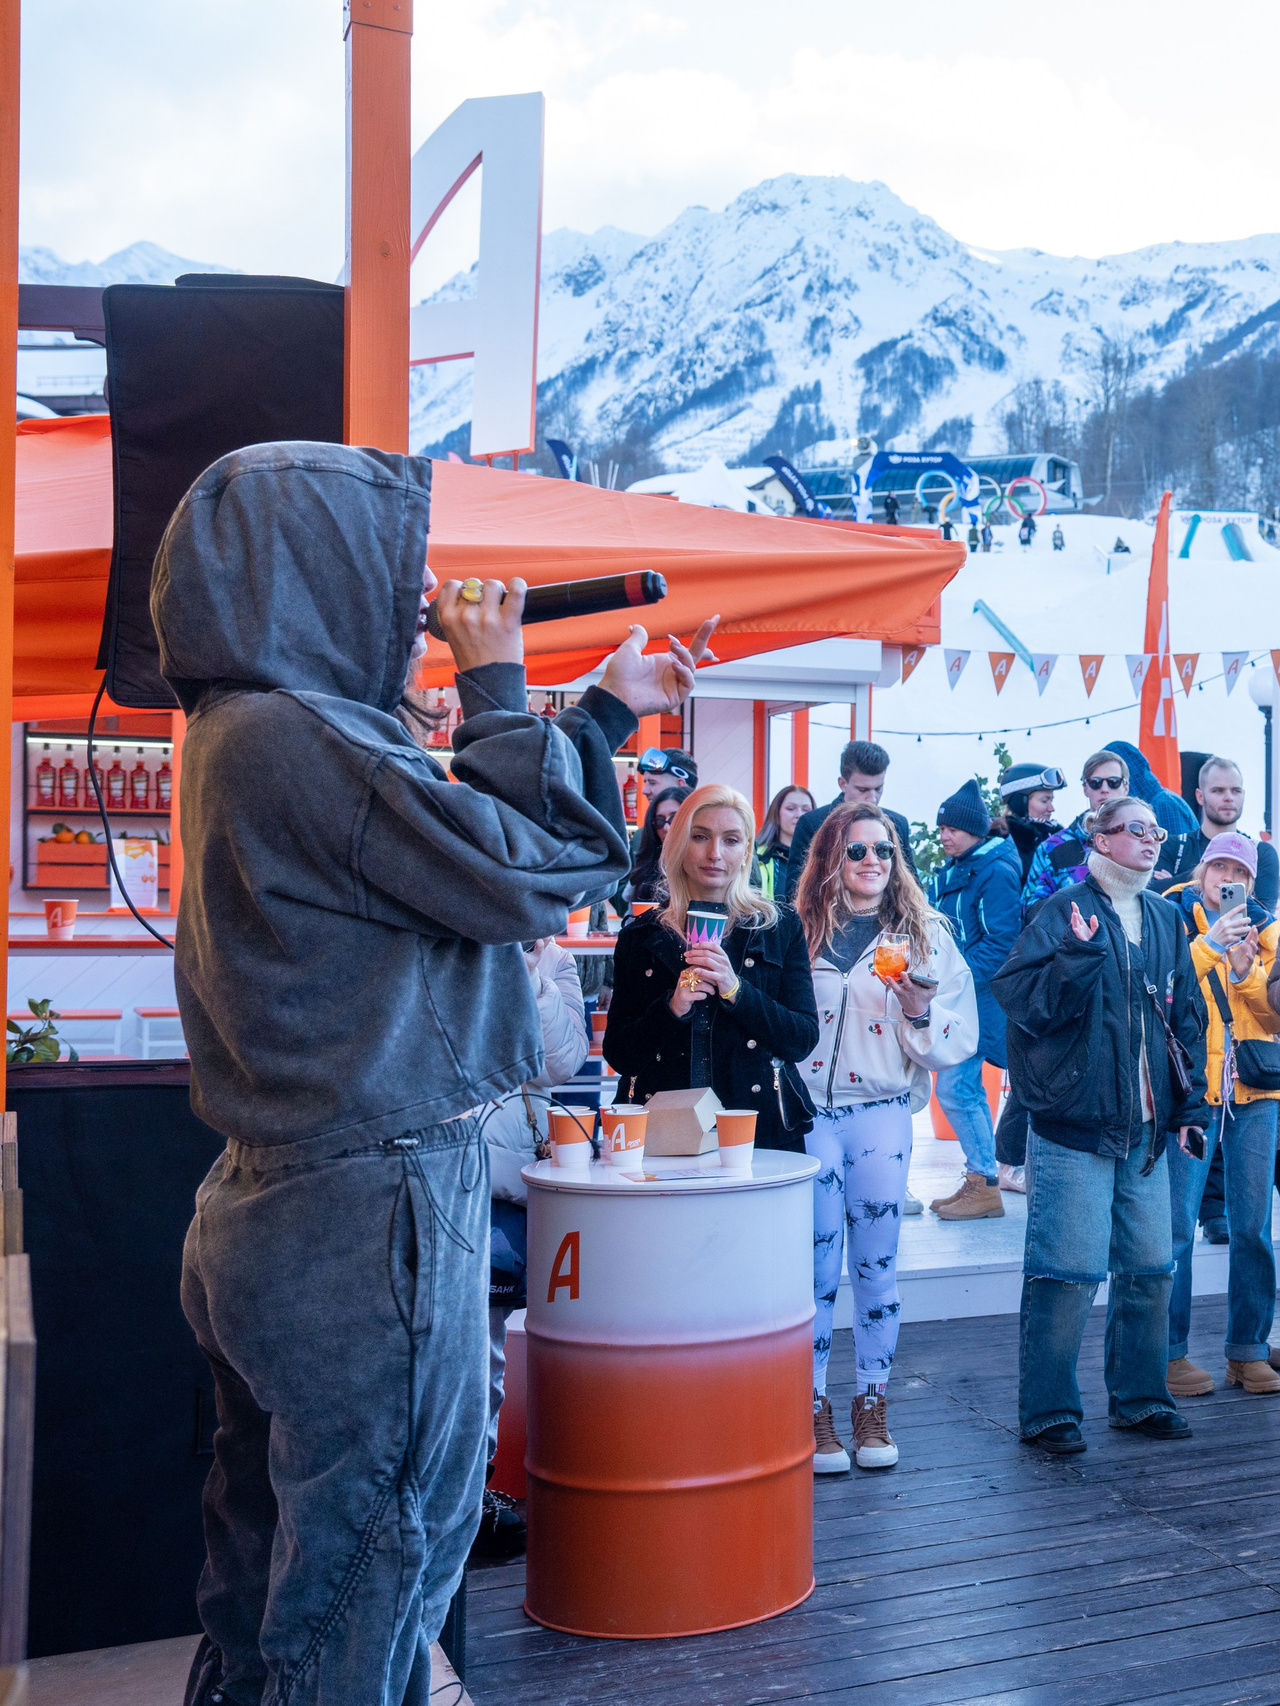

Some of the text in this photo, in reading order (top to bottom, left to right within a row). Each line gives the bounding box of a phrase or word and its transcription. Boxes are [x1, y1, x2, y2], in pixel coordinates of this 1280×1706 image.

[904, 651, 918, 665] A
[950, 657, 962, 671] A
[995, 659, 1007, 675] A
[1039, 660, 1050, 676] A
[1085, 661, 1097, 678] A
[1133, 661, 1144, 678] A
[1182, 659, 1192, 678] A
[1227, 659, 1239, 675] A
[611, 1123, 626, 1151] A
[547, 1231, 580, 1303] A
